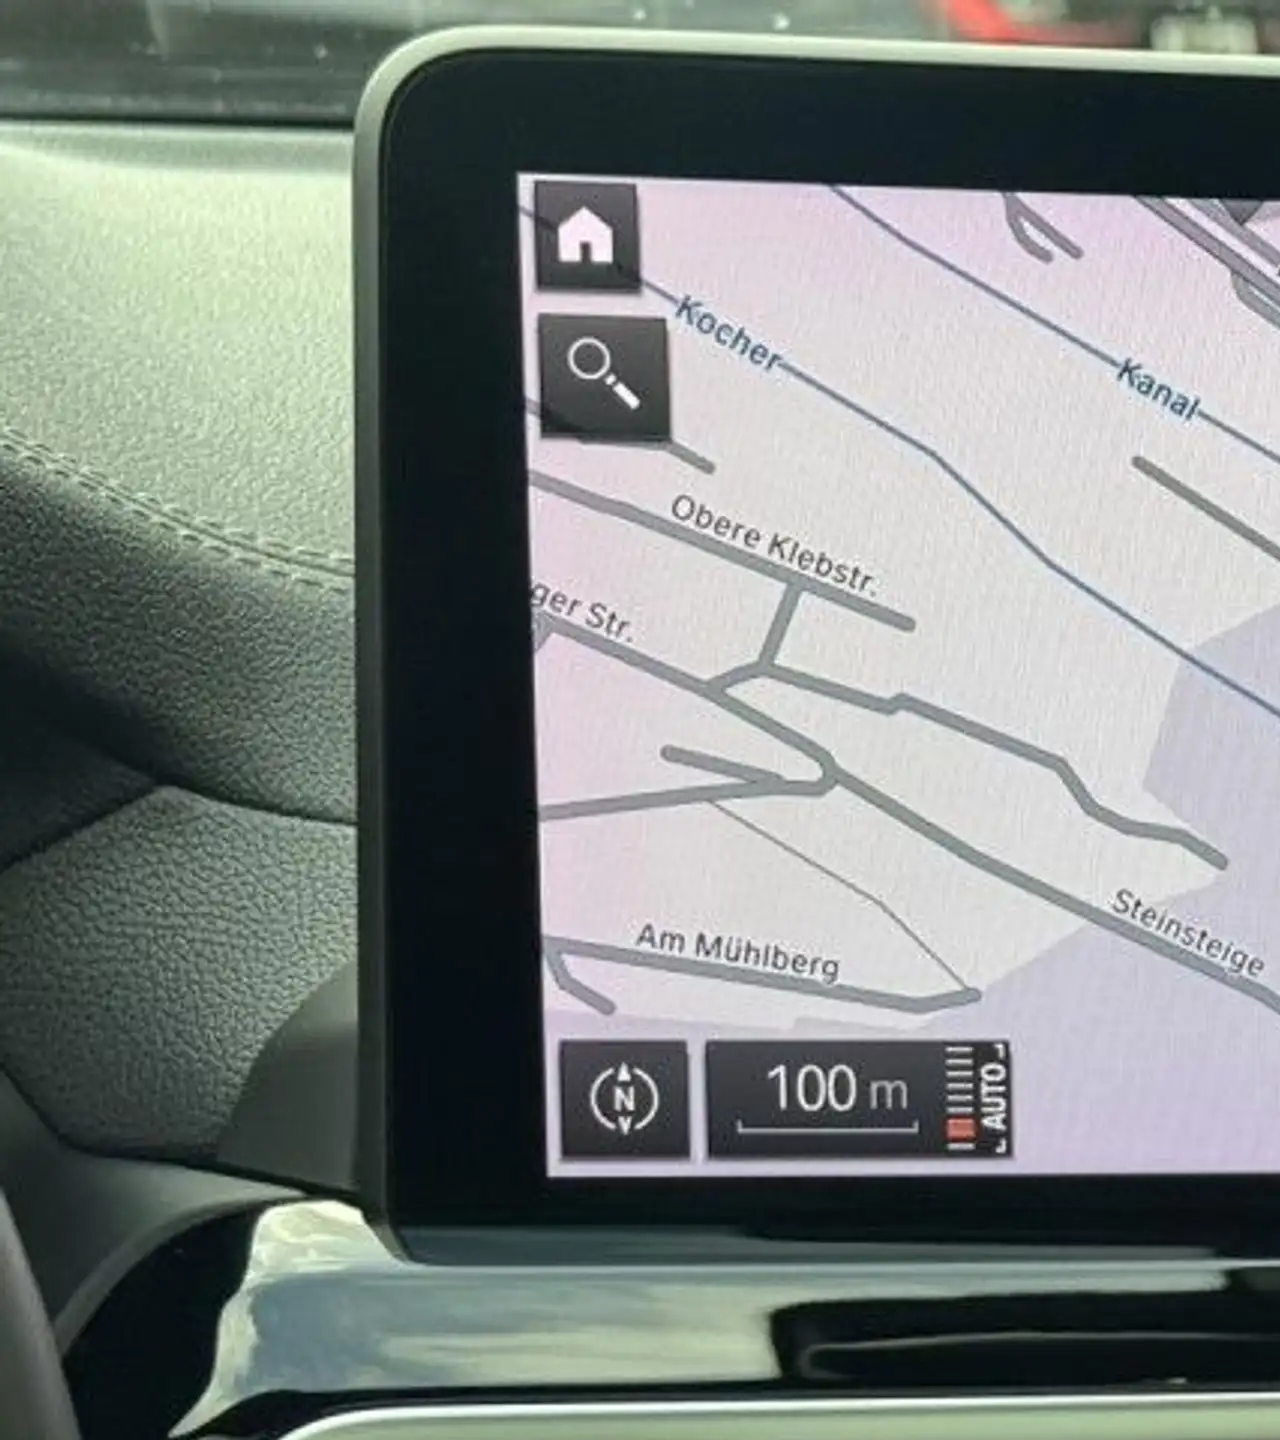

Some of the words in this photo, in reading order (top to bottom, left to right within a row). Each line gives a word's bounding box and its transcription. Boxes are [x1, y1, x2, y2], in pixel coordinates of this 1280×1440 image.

[674, 294, 784, 374] Kocher
[1116, 357, 1202, 421] Kanal
[669, 492, 763, 549] Obere
[767, 528, 879, 597] Klebstr.
[585, 601, 634, 642] Str.
[634, 923, 686, 953] Am
[694, 931, 841, 984] Mühlberg
[1109, 889, 1266, 978] Steinsteige
[614, 1086, 635, 1112] N
[767, 1065, 857, 1111] 100
[869, 1079, 908, 1109] m
[981, 1063, 1006, 1132] AUTO
